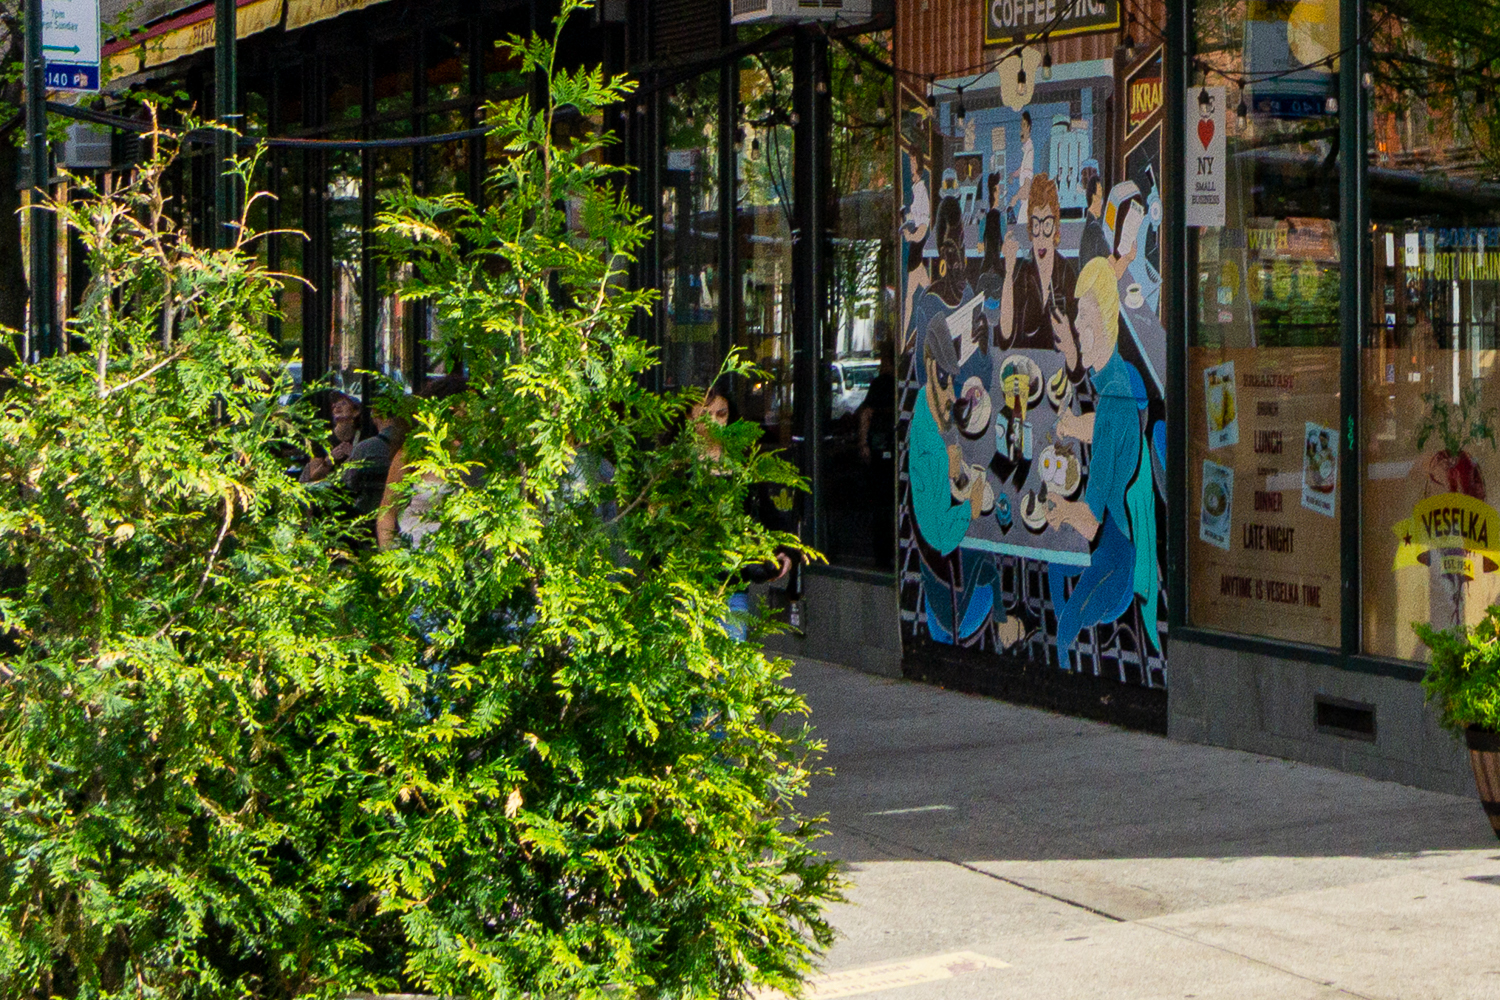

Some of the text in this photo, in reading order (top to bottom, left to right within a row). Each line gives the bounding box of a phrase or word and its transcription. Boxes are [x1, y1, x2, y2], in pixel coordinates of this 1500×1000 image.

[45, 72, 68, 87] 140
[1196, 156, 1215, 176] NY
[1195, 181, 1216, 192] SMALL
[1253, 429, 1283, 455] LUNCH
[1254, 490, 1283, 513] DINNER
[1243, 522, 1265, 550] LATE
[1265, 525, 1295, 553] NIGHT
[1421, 507, 1489, 548] VESELKA
[1220, 573, 1321, 608] ANYTIME IS VESELKA TIME
